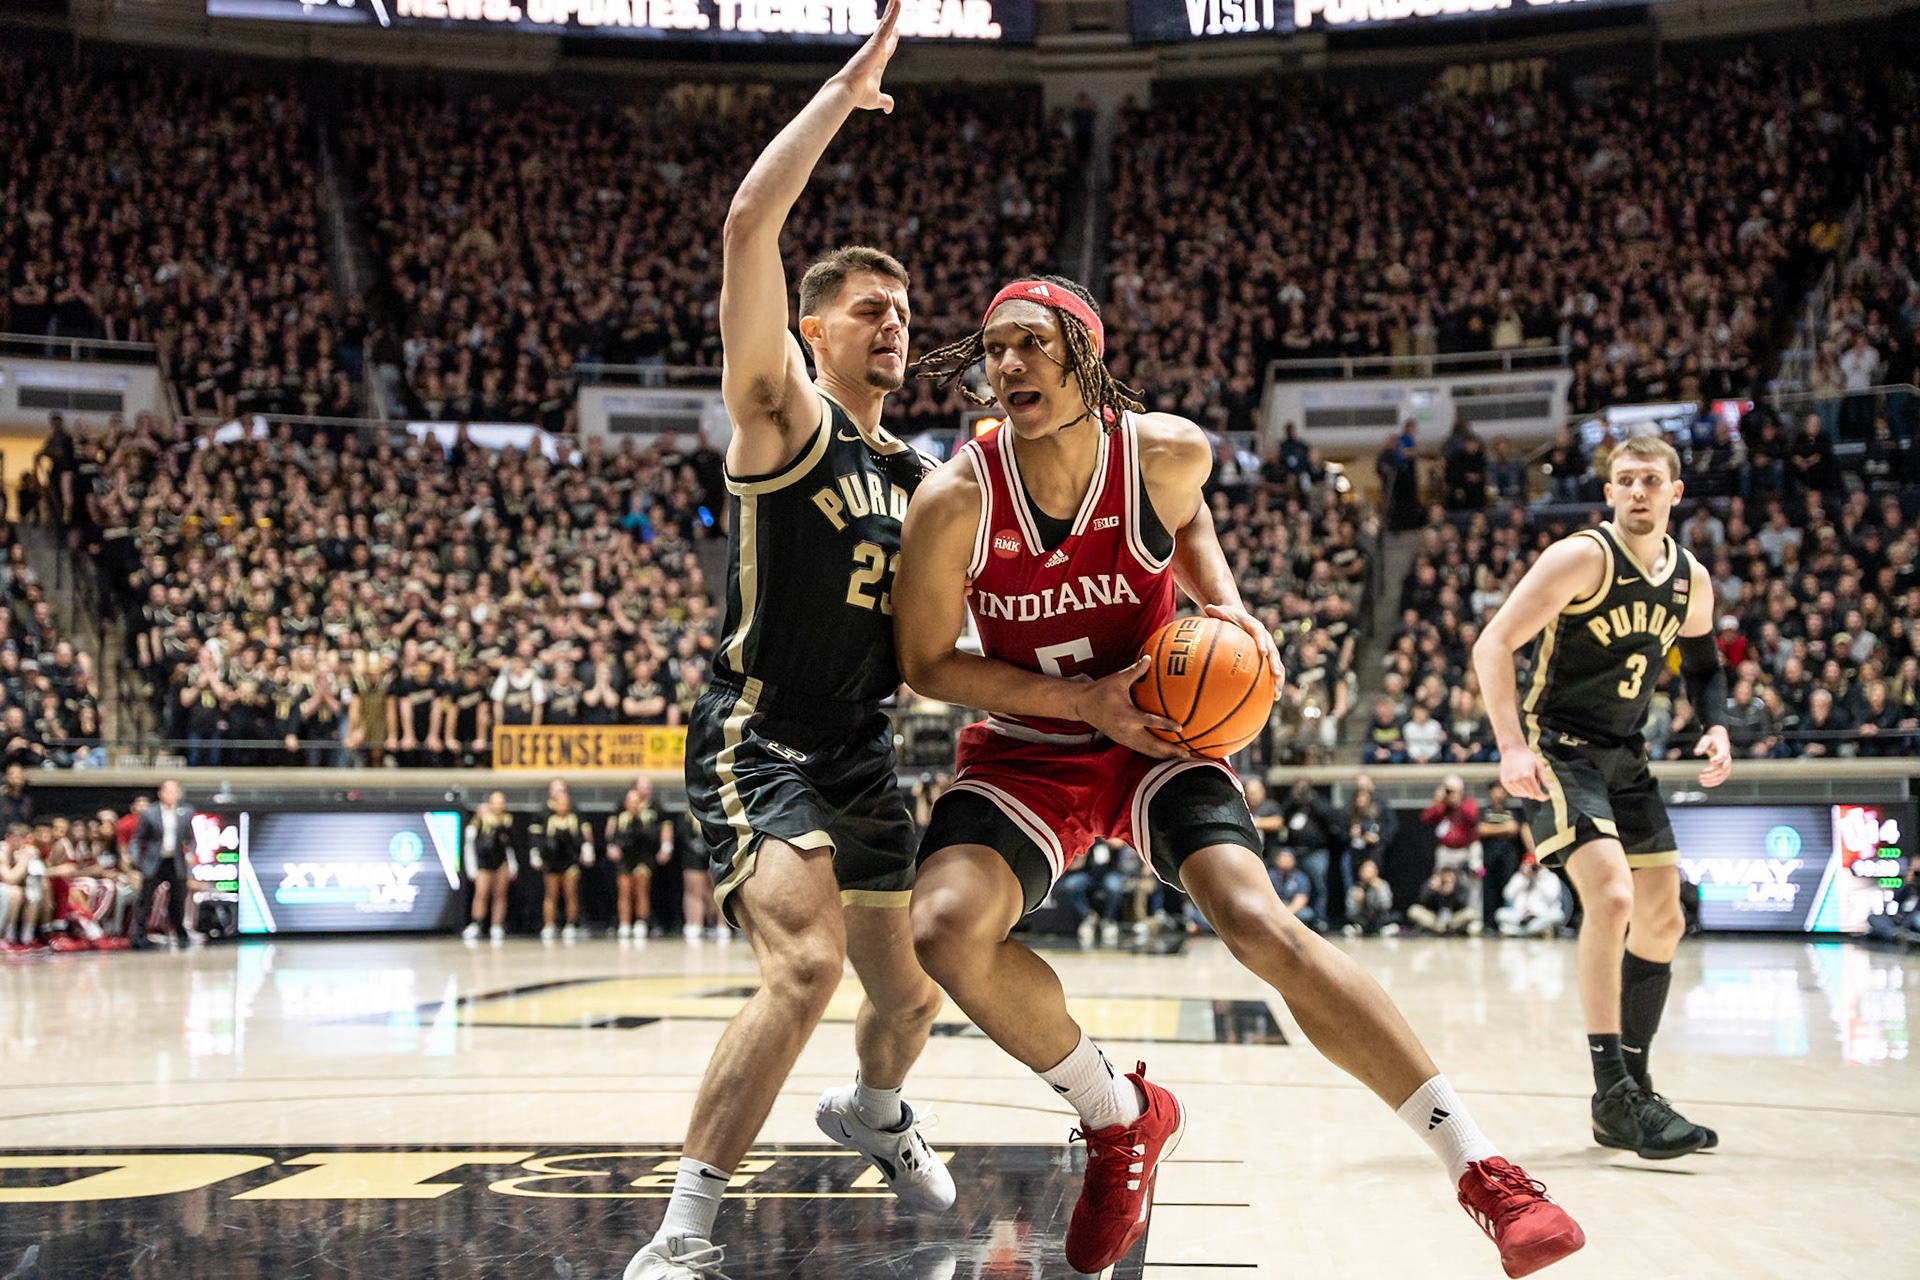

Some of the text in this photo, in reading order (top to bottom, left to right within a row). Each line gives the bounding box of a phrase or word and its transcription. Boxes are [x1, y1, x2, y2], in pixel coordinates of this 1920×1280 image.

[1185, 0, 1275, 36] VISIT
[812, 471, 909, 533] PURD
[994, 537, 1021, 552] RMK
[1044, 555, 1070, 568] adidas
[978, 574, 1141, 622] INDIANA
[1617, 653, 1649, 700] 3
[500, 733, 604, 766] DEFENSE
[1678, 858, 1804, 886] YWAY
